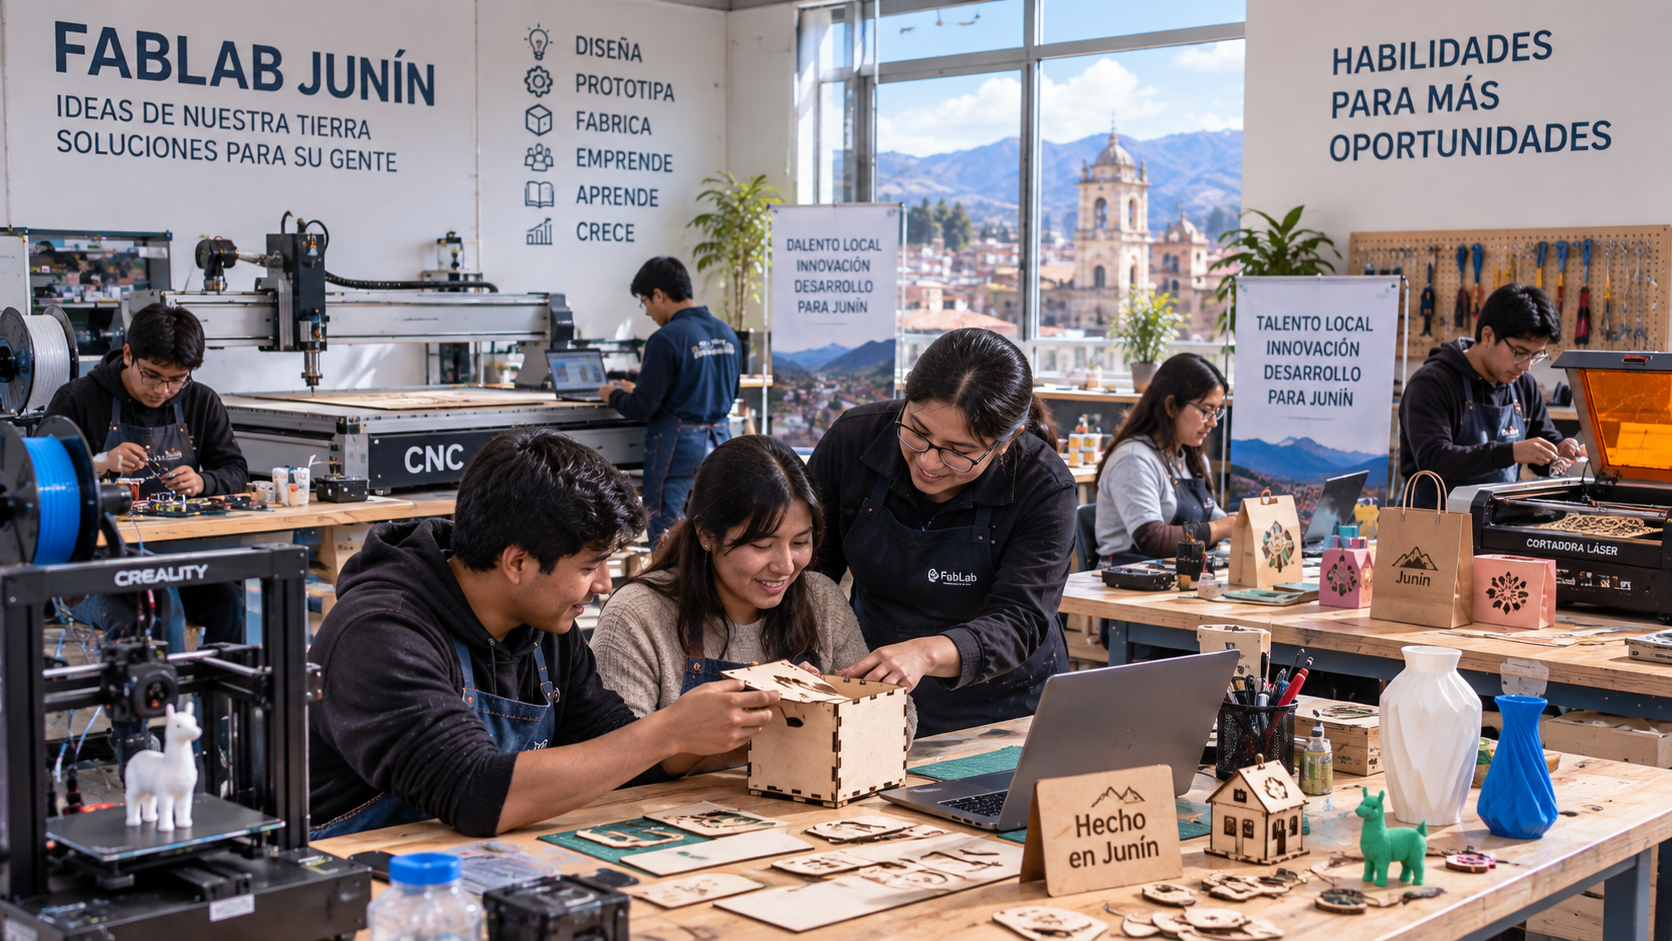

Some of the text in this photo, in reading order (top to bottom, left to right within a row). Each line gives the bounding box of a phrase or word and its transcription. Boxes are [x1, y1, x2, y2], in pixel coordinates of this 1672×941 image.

[575, 34, 643, 63] DISEÑA
[1332, 29, 1554, 76] HABILIDADES
[54, 20, 435, 107] FABLAB JUNÍN
[576, 73, 675, 102] PROTOTIPA
[1331, 74, 1500, 119] PARA MÁS
[56, 94, 371, 141] IDEAS DE NUESTRA TIERRA
[576, 110, 652, 136] FABRICA
[56, 129, 398, 173] SOLUCIONES PARA SU GENTE
[1329, 120, 1612, 162] OPORTUNIDADES
[576, 147, 673, 173] EMPRENDE
[576, 185, 659, 208] APRENDE
[576, 221, 635, 243] CRECE
[786, 238, 883, 252] DALENTO LOCAL
[796, 256, 870, 273] INNOVACIÓN
[794, 279, 874, 293] DESARROLLO
[798, 297, 868, 314] PARA JUNÍN
[1256, 315, 1374, 332] TALENTO LOCAL
[1266, 337, 1360, 357] INNOVACIÓN
[1264, 364, 1362, 382] DESARROLLO
[1268, 389, 1306, 406] PARA
[404, 443, 465, 474] CNC
[1526, 538, 1619, 556] CORTADORA LÁSER
[113, 563, 209, 587] CREALITY
[1075, 808, 1146, 838] Hecho
[1069, 834, 1160, 869] en Junín
